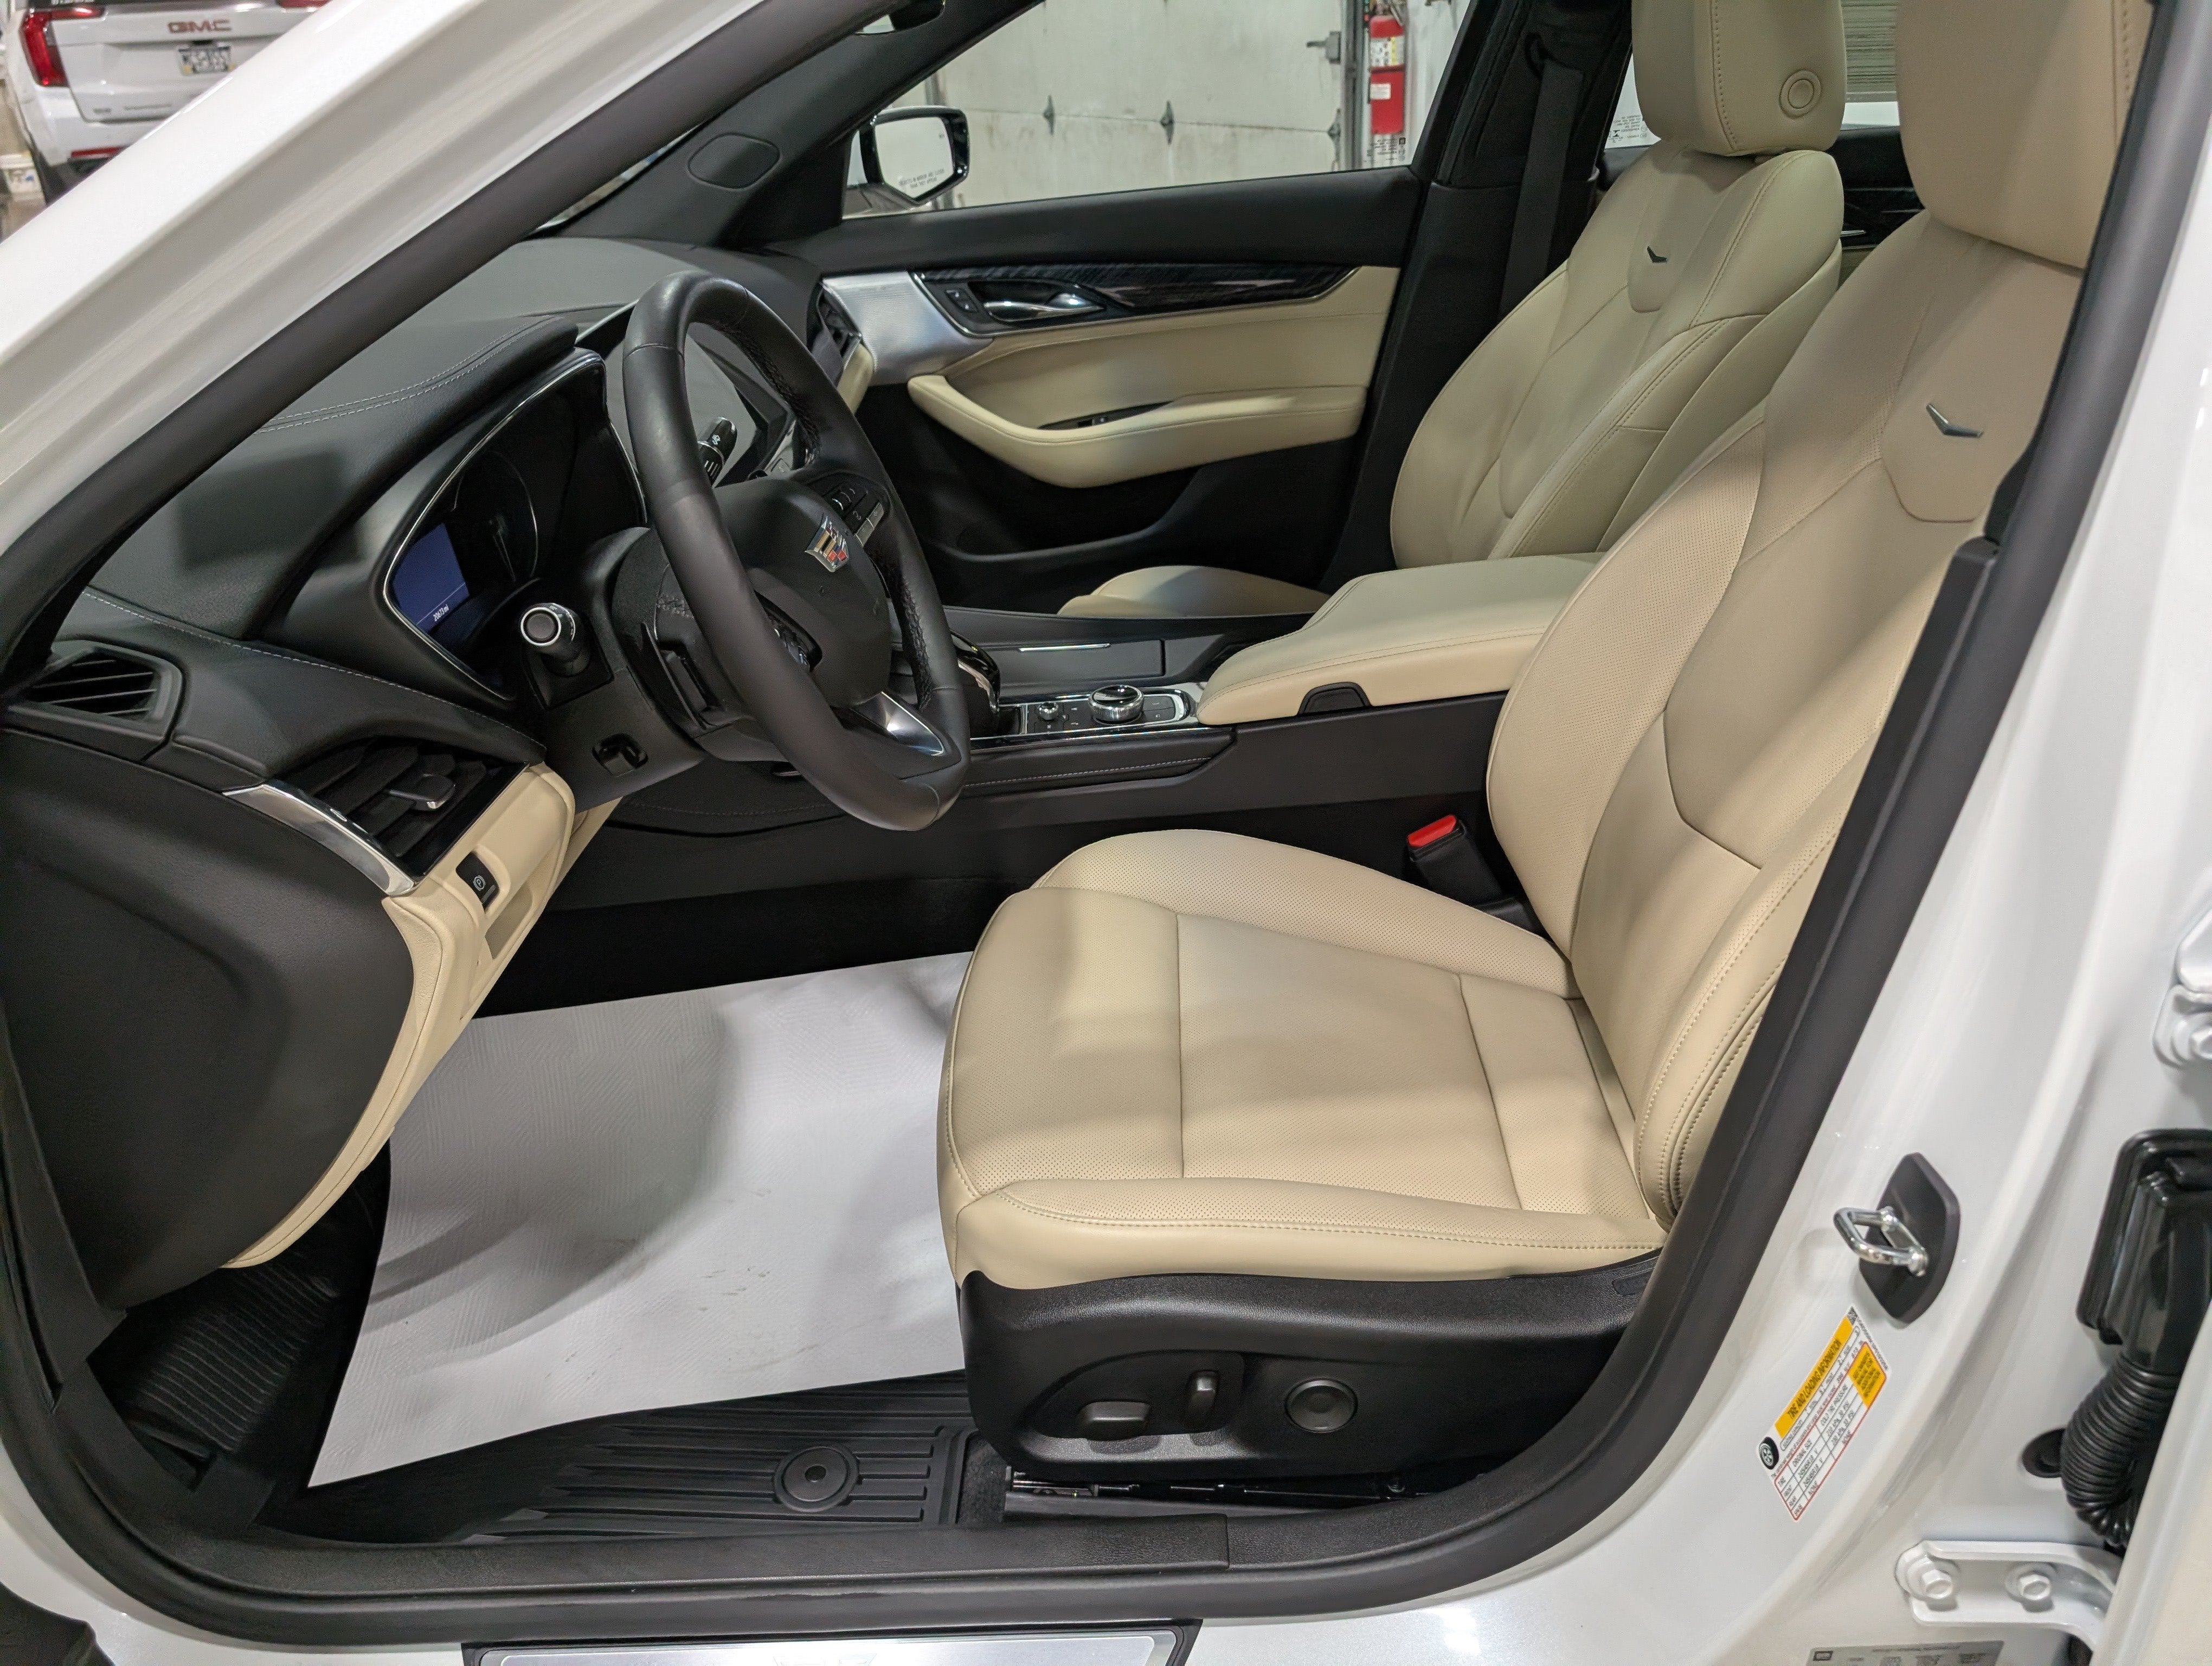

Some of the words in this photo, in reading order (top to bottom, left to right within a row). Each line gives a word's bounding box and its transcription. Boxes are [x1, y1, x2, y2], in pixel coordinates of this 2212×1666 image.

[168, 19, 232, 33] GMC
[1787, 1402, 1798, 1419] TIRE
[1795, 1392, 1805, 1408] AND
[1802, 1369, 1821, 1398] LOADING
[1816, 1336, 1842, 1375] INFORMATION
